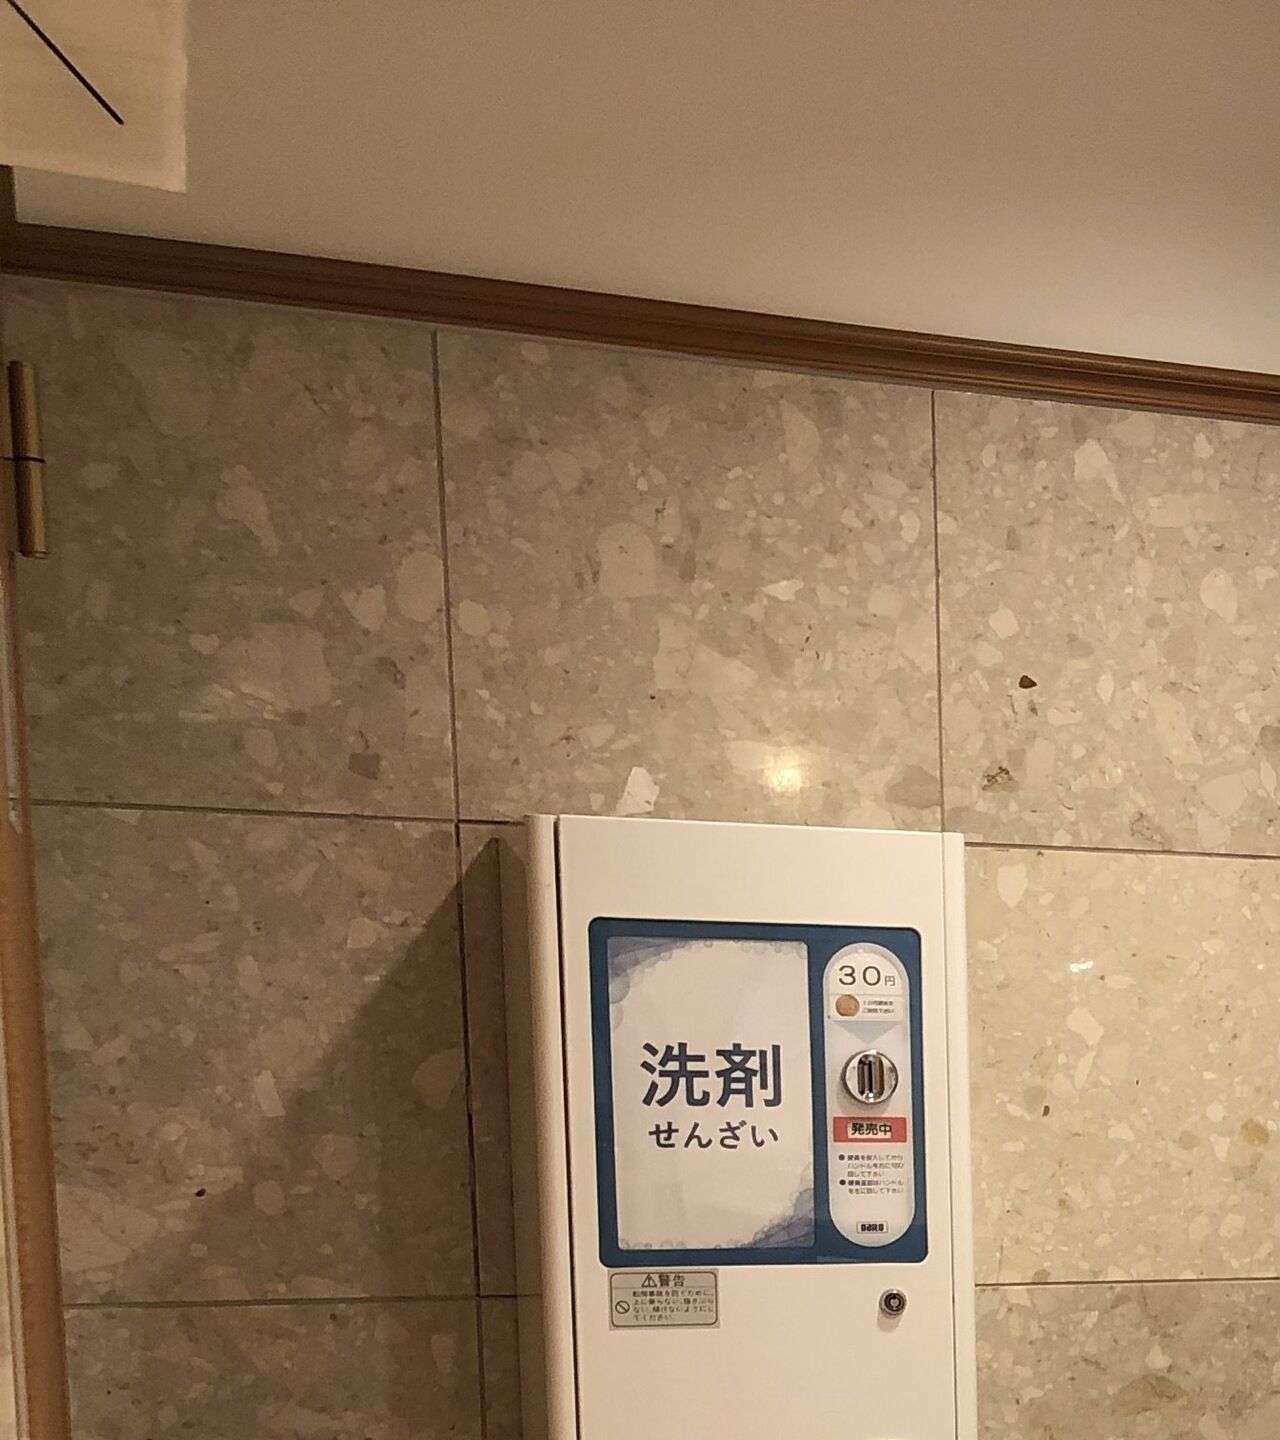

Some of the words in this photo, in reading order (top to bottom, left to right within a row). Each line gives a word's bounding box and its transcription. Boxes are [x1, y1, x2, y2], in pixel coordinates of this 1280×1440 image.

[639, 1041, 783, 1109] 洗剤
[648, 1119, 780, 1150] せんざい
[850, 1121, 893, 1138] 発売中
